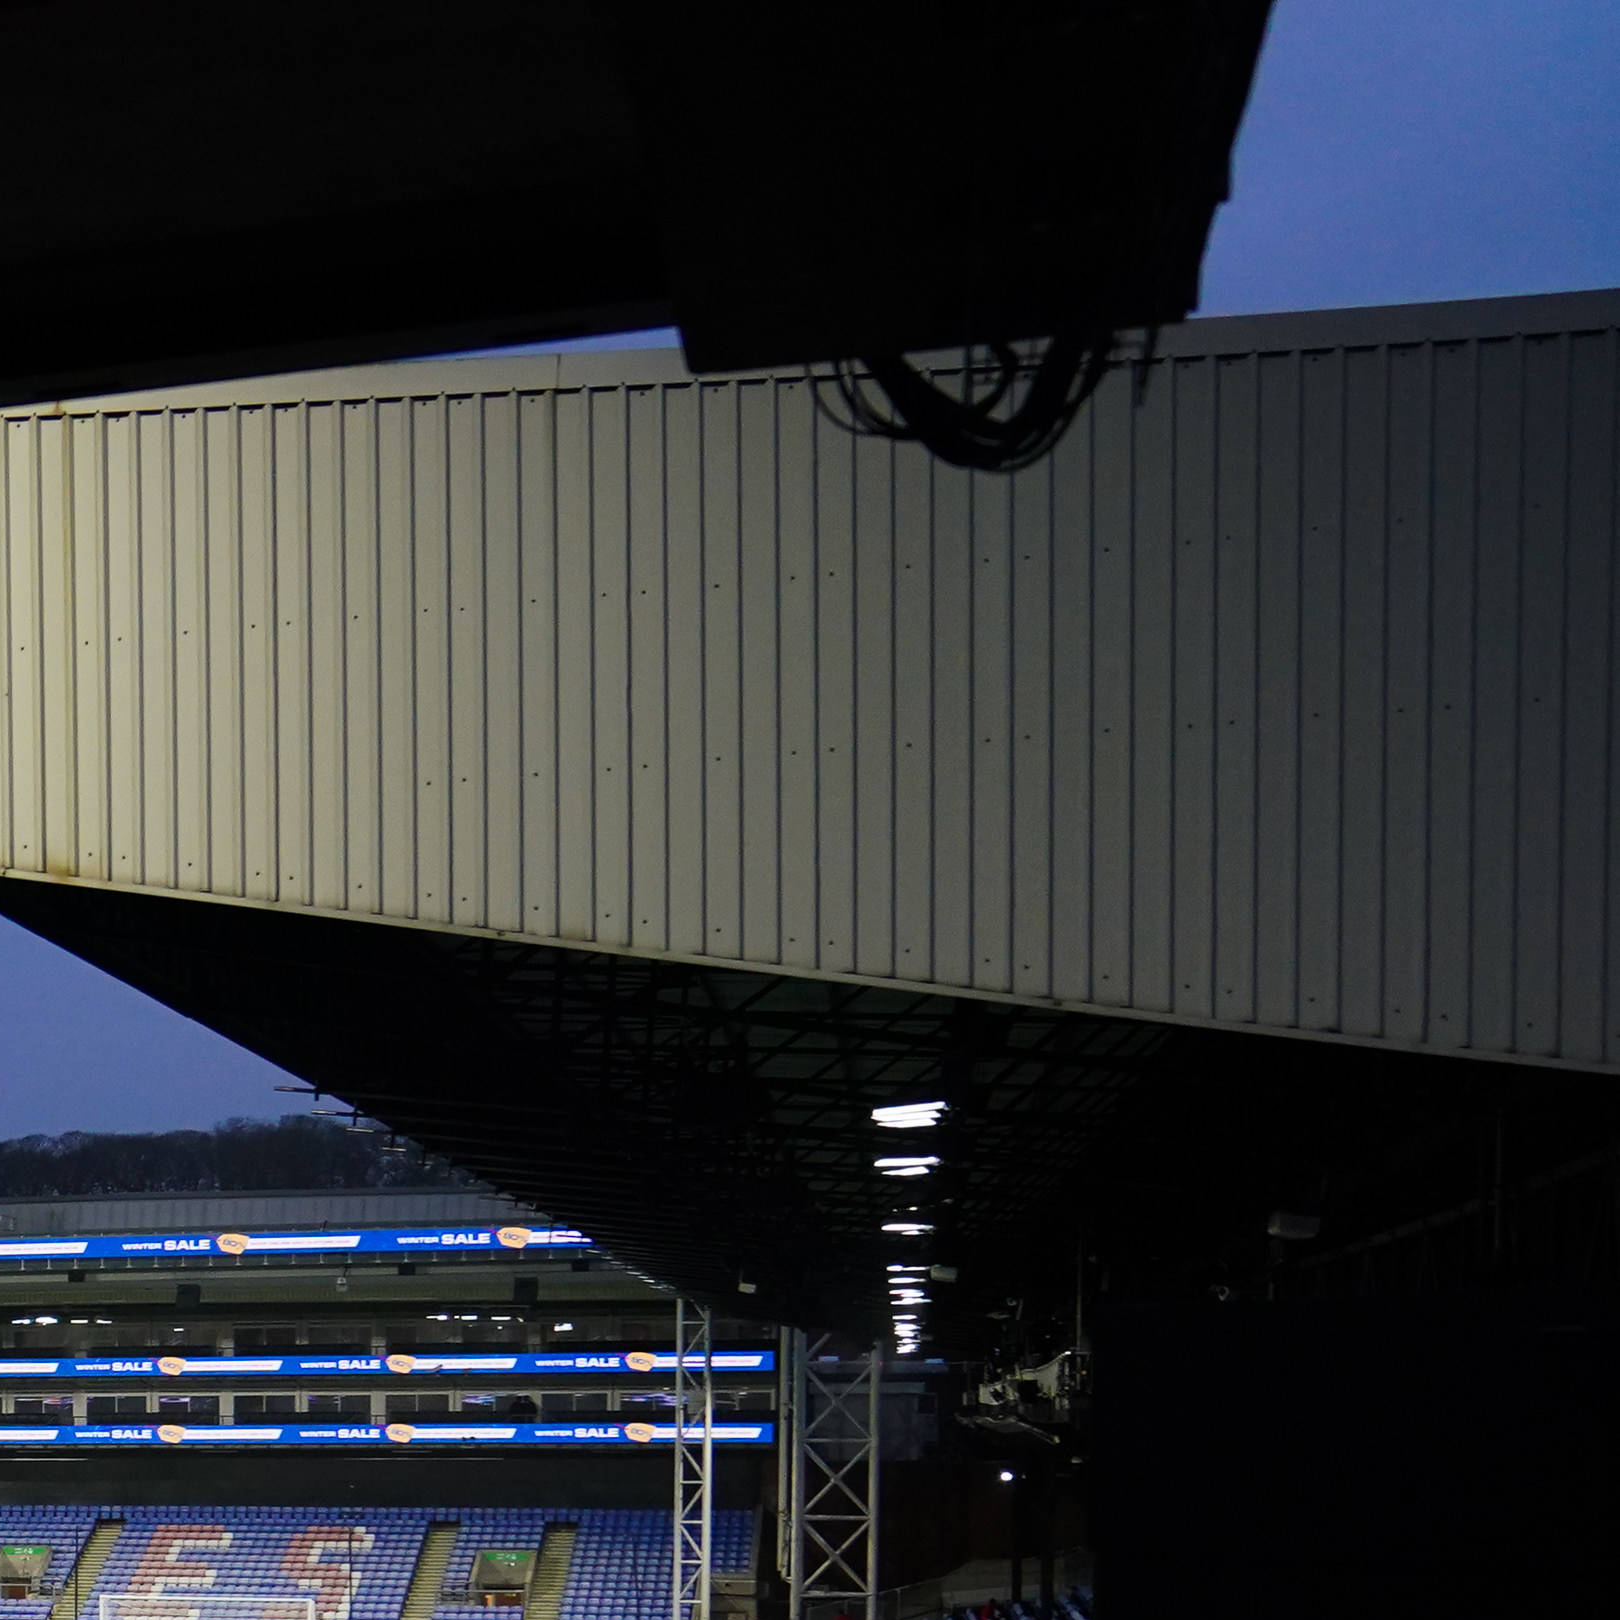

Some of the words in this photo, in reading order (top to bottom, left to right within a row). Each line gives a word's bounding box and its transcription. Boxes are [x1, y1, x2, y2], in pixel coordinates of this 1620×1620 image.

[441, 1233, 490, 1245] SALE
[164, 1240, 210, 1251] SALE
[112, 1362, 152, 1372] SALE
[339, 1360, 380, 1370] SALE
[576, 1358, 619, 1368] SALE
[112, 1430, 152, 1440] SALE
[338, 1429, 380, 1439] SALE
[575, 1428, 619, 1438] SALE
